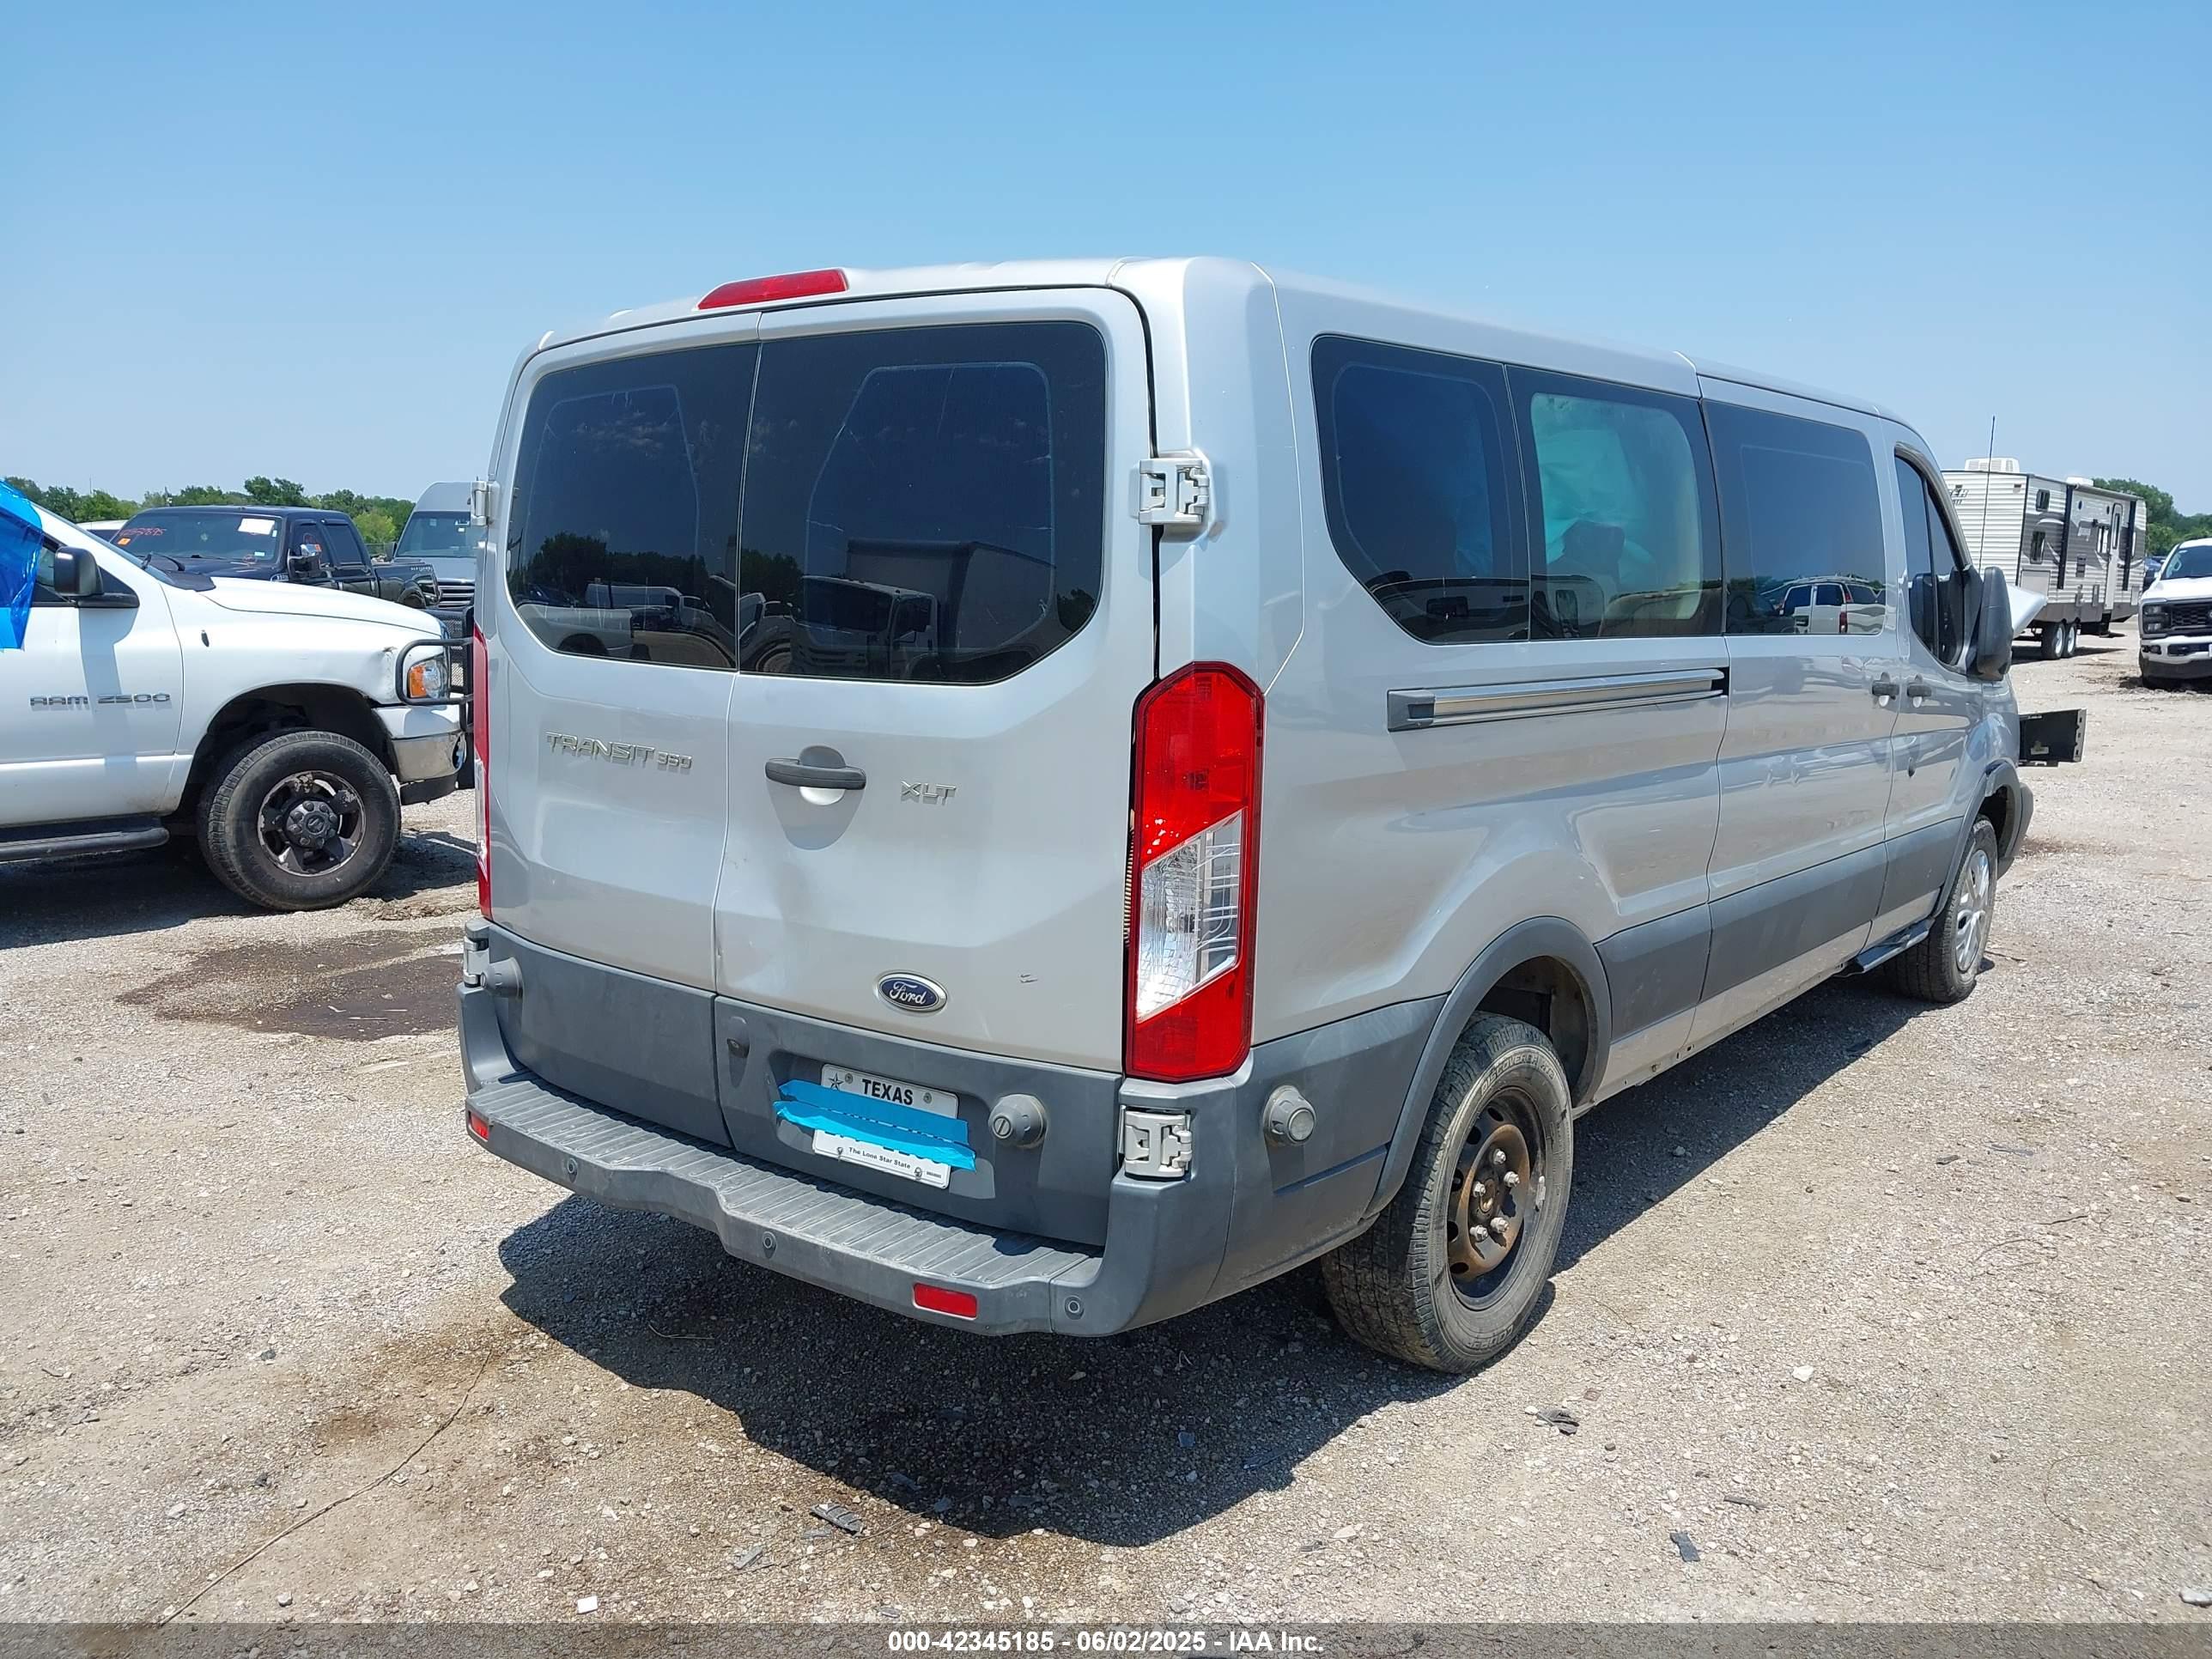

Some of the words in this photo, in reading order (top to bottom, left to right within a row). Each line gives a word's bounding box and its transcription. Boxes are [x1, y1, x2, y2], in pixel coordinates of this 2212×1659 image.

[30, 696, 88, 706] RAM
[98, 694, 170, 704] 2500
[544, 731, 656, 762] TRANSIT
[657, 751, 693, 769] 350
[900, 781, 957, 800] XLT
[889, 981, 927, 1005] Ford
[1481, 1052, 1540, 1096] DISCOVERER
[862, 1079, 914, 1106] TEXAS
[848, 1146, 861, 1157] The
[863, 1150, 878, 1161] Lone
[878, 1155, 894, 1165] Star
[894, 1159, 911, 1170] State
[1466, 1326, 1513, 1348] COOPER
